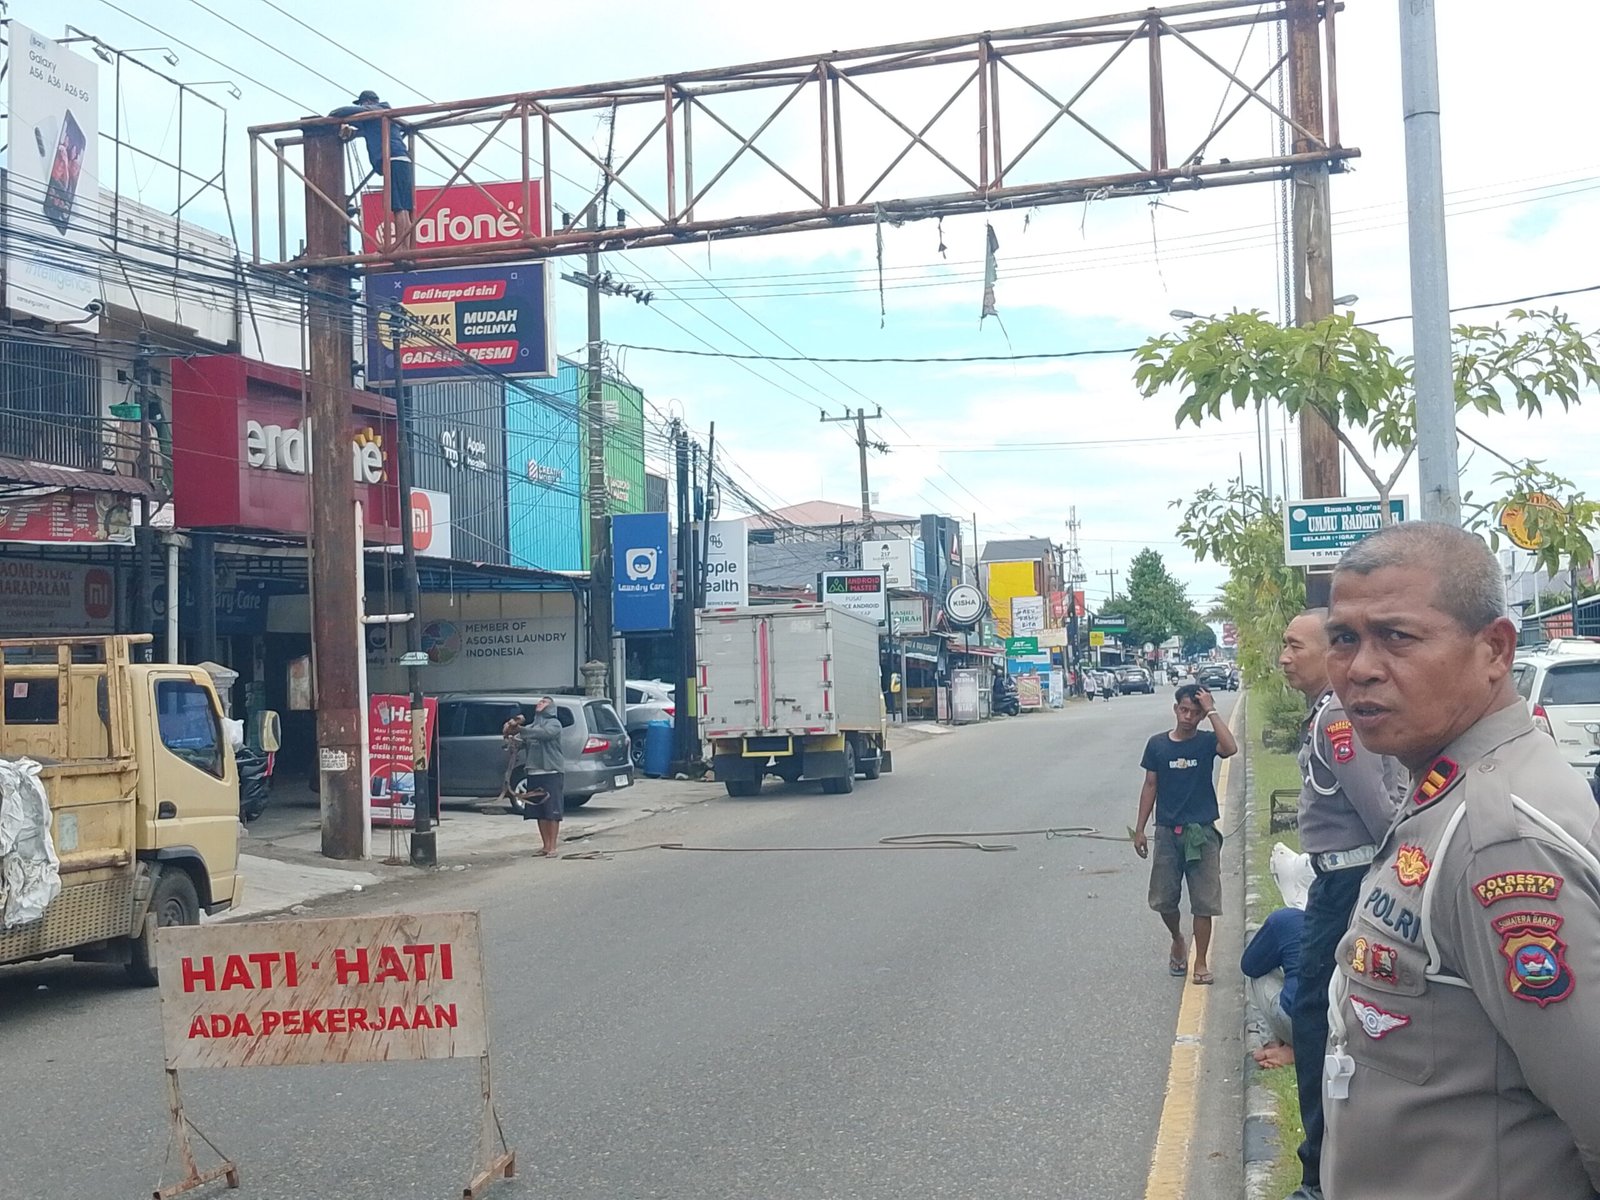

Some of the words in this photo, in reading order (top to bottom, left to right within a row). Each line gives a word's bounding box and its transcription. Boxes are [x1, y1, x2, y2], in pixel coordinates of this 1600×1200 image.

[29, 50, 57, 73] Galaxy
[29, 65, 43, 80] A56
[47, 74, 61, 88] A36
[64, 82, 78, 97] A26
[79, 89, 89, 102] 5G
[412, 288, 434, 300] Beli
[463, 285, 474, 296] di
[476, 284, 498, 296] sini
[463, 309, 518, 324] MUDAH
[464, 323, 517, 336] CICILNYA
[468, 346, 513, 361] RESMI
[467, 436, 486, 456] Apple
[1324, 504, 1353, 513] Rumah
[1308, 514, 1338, 532] UMMU
[618, 583, 649, 593] Laundry
[649, 582, 666, 591] Care
[953, 599, 977, 607] KISHA
[465, 622, 509, 633] MEMBER
[512, 621, 527, 631] OF
[466, 634, 514, 645] ASOSIASI
[516, 632, 567, 643] LAUNDRY
[466, 647, 524, 657] INDONESIA
[1478, 874, 1555, 898] POLRESTA
[1486, 884, 1548, 900] PADANG
[1363, 886, 1421, 943] POLRI
[1498, 915, 1532, 927] SUMATERA
[1532, 915, 1557, 927] BARAT
[181, 951, 299, 993] HATI
[335, 943, 453, 985] HATI
[188, 1012, 254, 1039] ADA
[261, 1003, 458, 1036] PEKERJAAN
